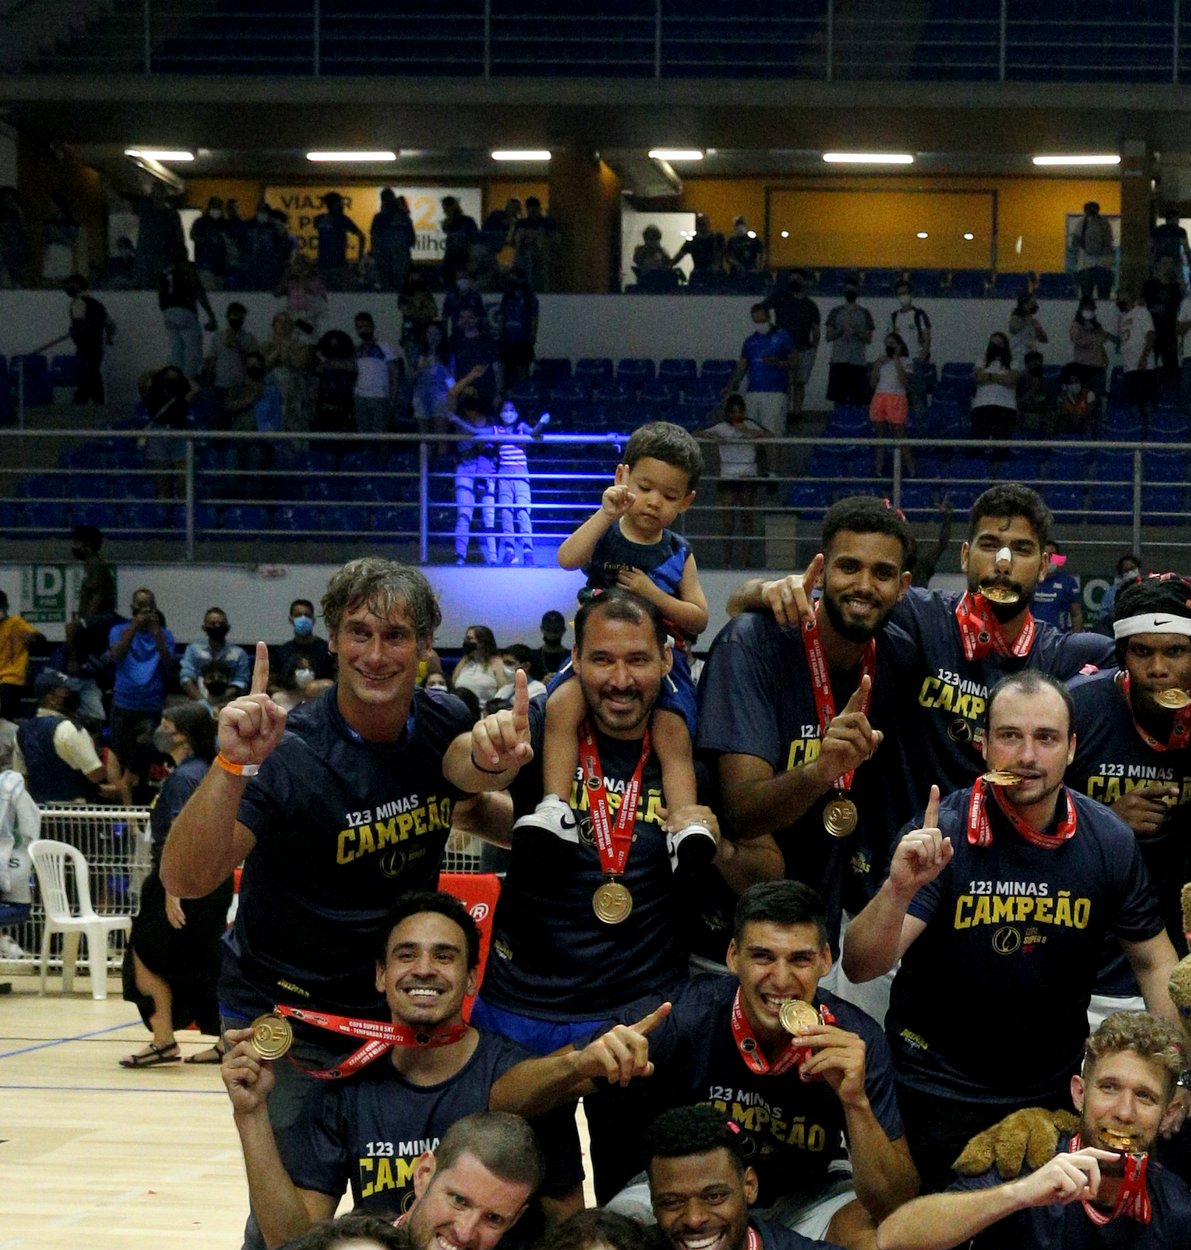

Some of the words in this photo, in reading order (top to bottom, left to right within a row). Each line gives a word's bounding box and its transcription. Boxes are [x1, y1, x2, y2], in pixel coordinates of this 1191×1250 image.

[36, 566, 61, 596] D
[1083, 579, 1109, 611] C
[918, 676, 986, 720] CAMP
[938, 668, 959, 686] 123
[958, 678, 990, 698] MINA
[801, 725, 816, 738] 12
[1099, 764, 1124, 776] 123
[1127, 764, 1174, 780] MINAS
[345, 810, 372, 827] 123
[376, 794, 419, 820] MINAS
[336, 795, 451, 865] CAMPEÃO
[969, 881, 992, 895] 123
[996, 881, 1048, 896] MINAS
[954, 890, 1091, 930] CAMPEÃO
[709, 1086, 733, 1100] 123
[736, 1090, 783, 1119] MINAS
[695, 1100, 825, 1152] MPEÃO
[366, 1142, 394, 1157] 123
[399, 1137, 440, 1157] MINA
